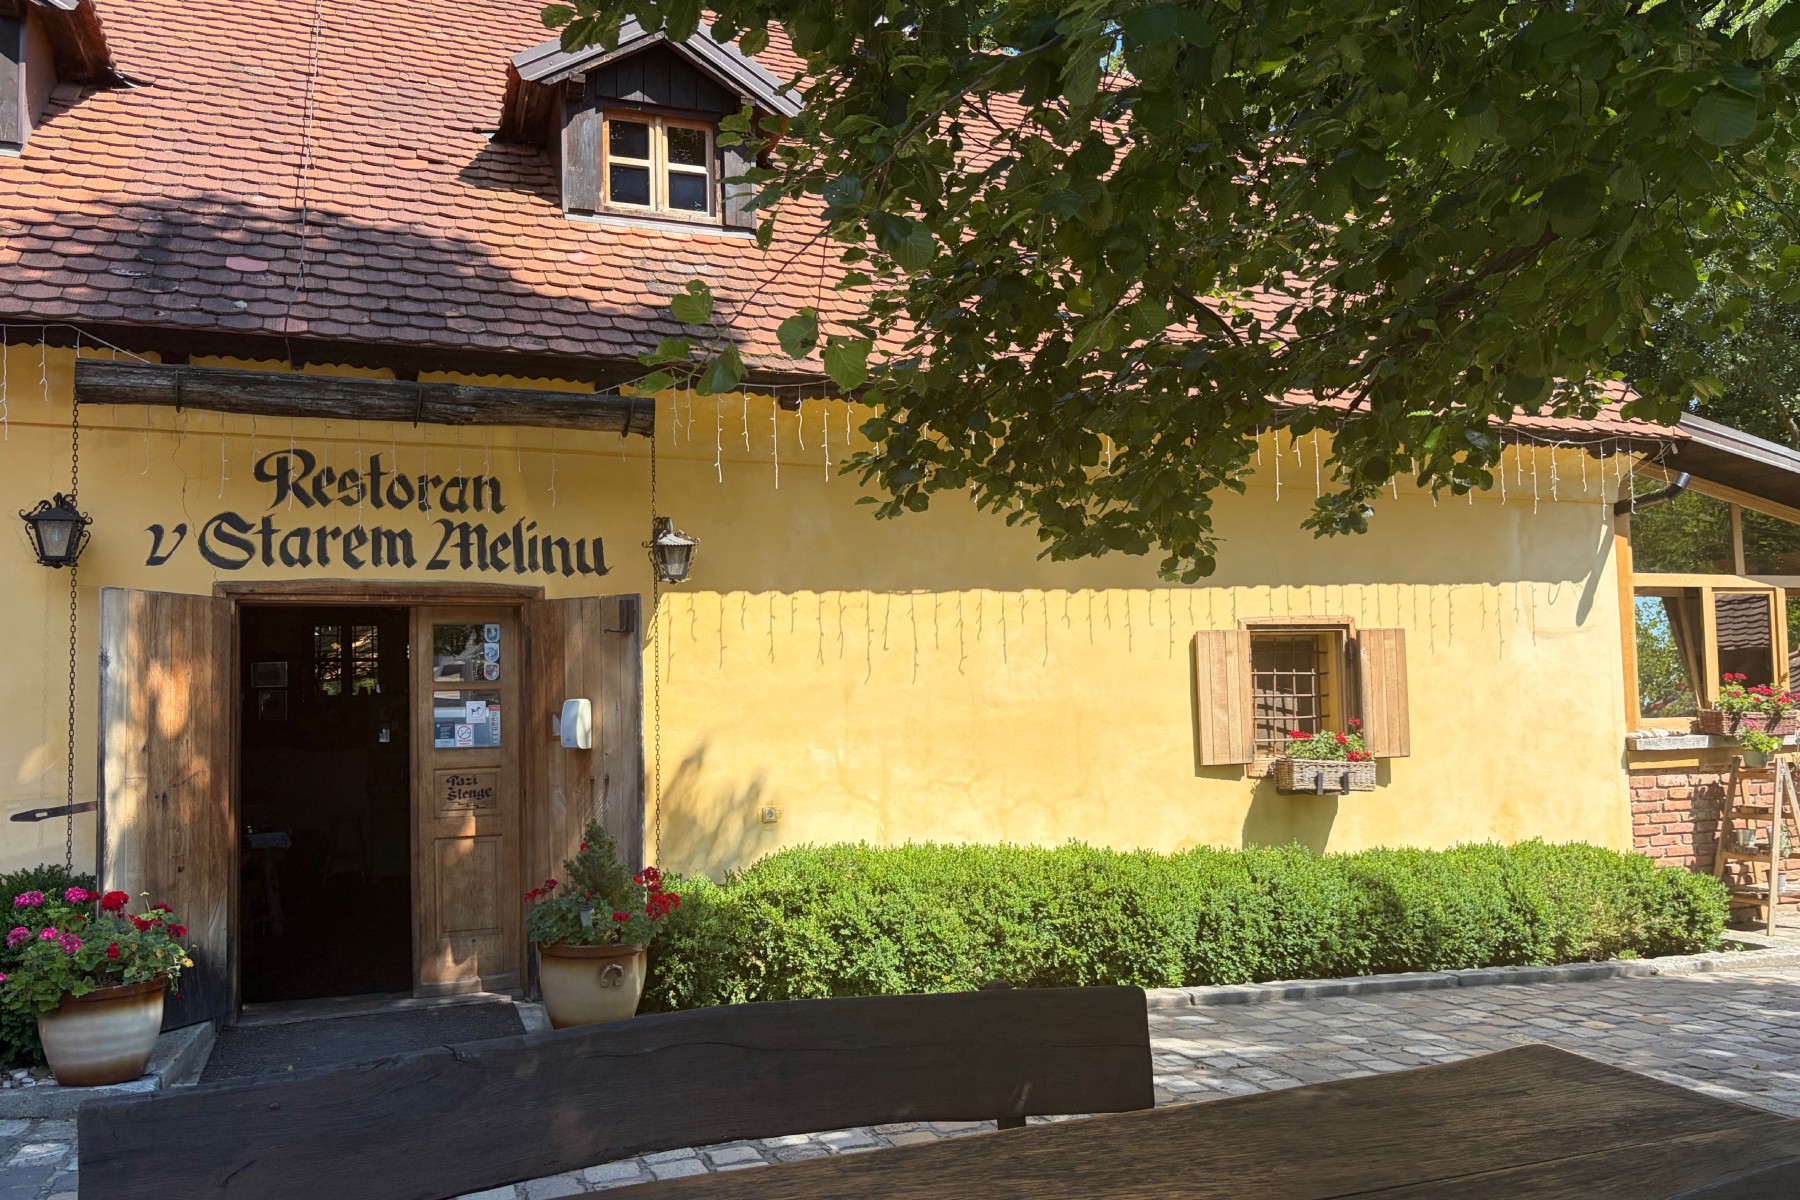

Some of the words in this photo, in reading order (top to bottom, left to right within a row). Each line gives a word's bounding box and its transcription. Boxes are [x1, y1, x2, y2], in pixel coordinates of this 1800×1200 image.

[254, 448, 506, 514] Restoran
[198, 511, 418, 571] Starem
[425, 516, 614, 577] Melinu
